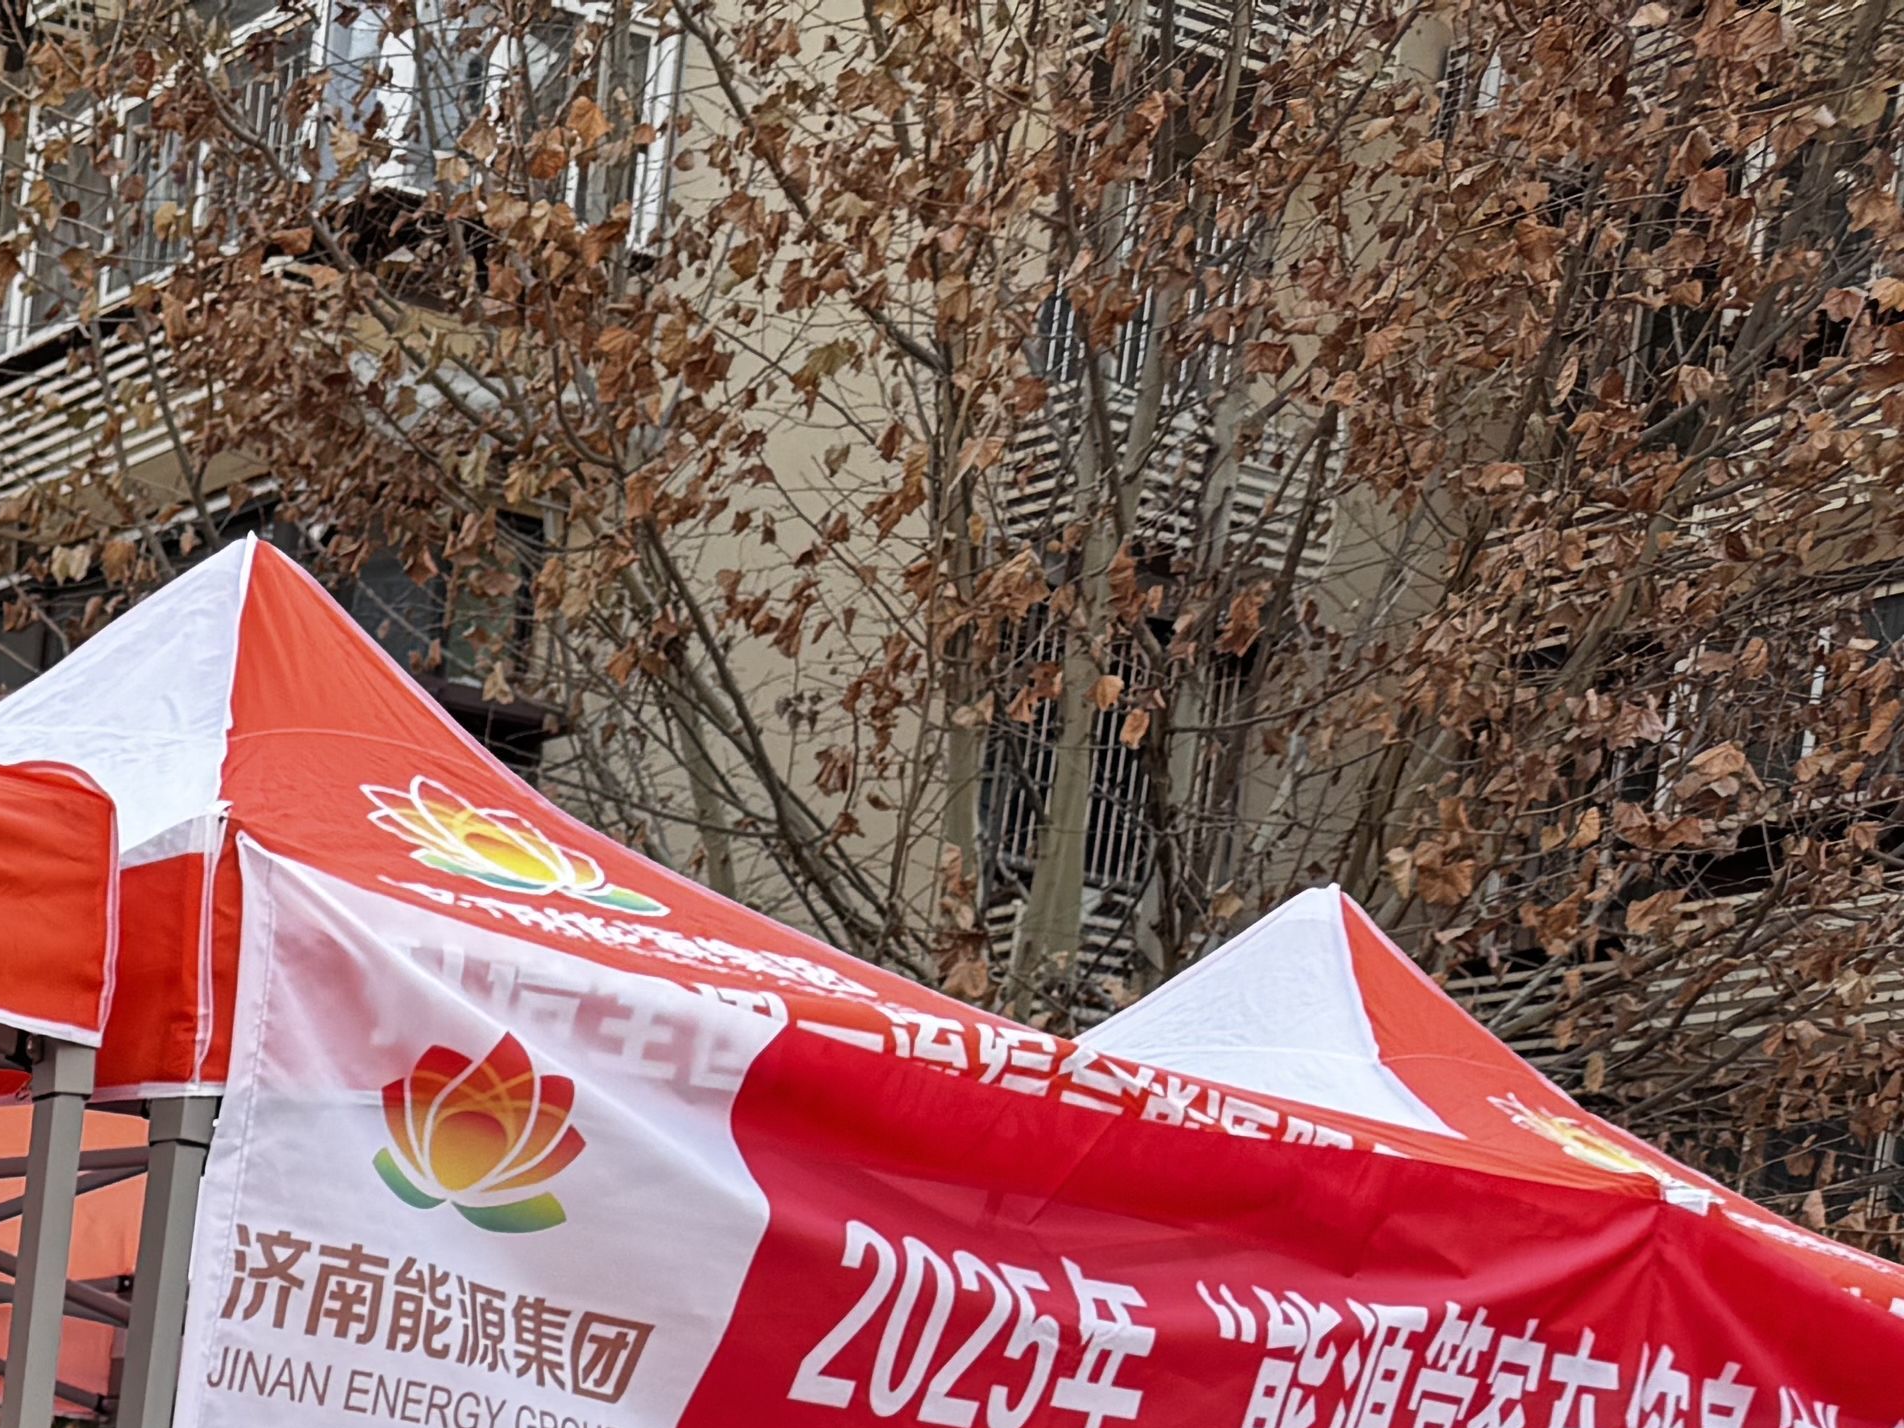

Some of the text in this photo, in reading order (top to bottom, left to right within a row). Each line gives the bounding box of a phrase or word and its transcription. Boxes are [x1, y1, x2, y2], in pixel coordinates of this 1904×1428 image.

[219, 1222, 656, 1405] 济南能源集团
[207, 1345, 331, 1407] JINAN
